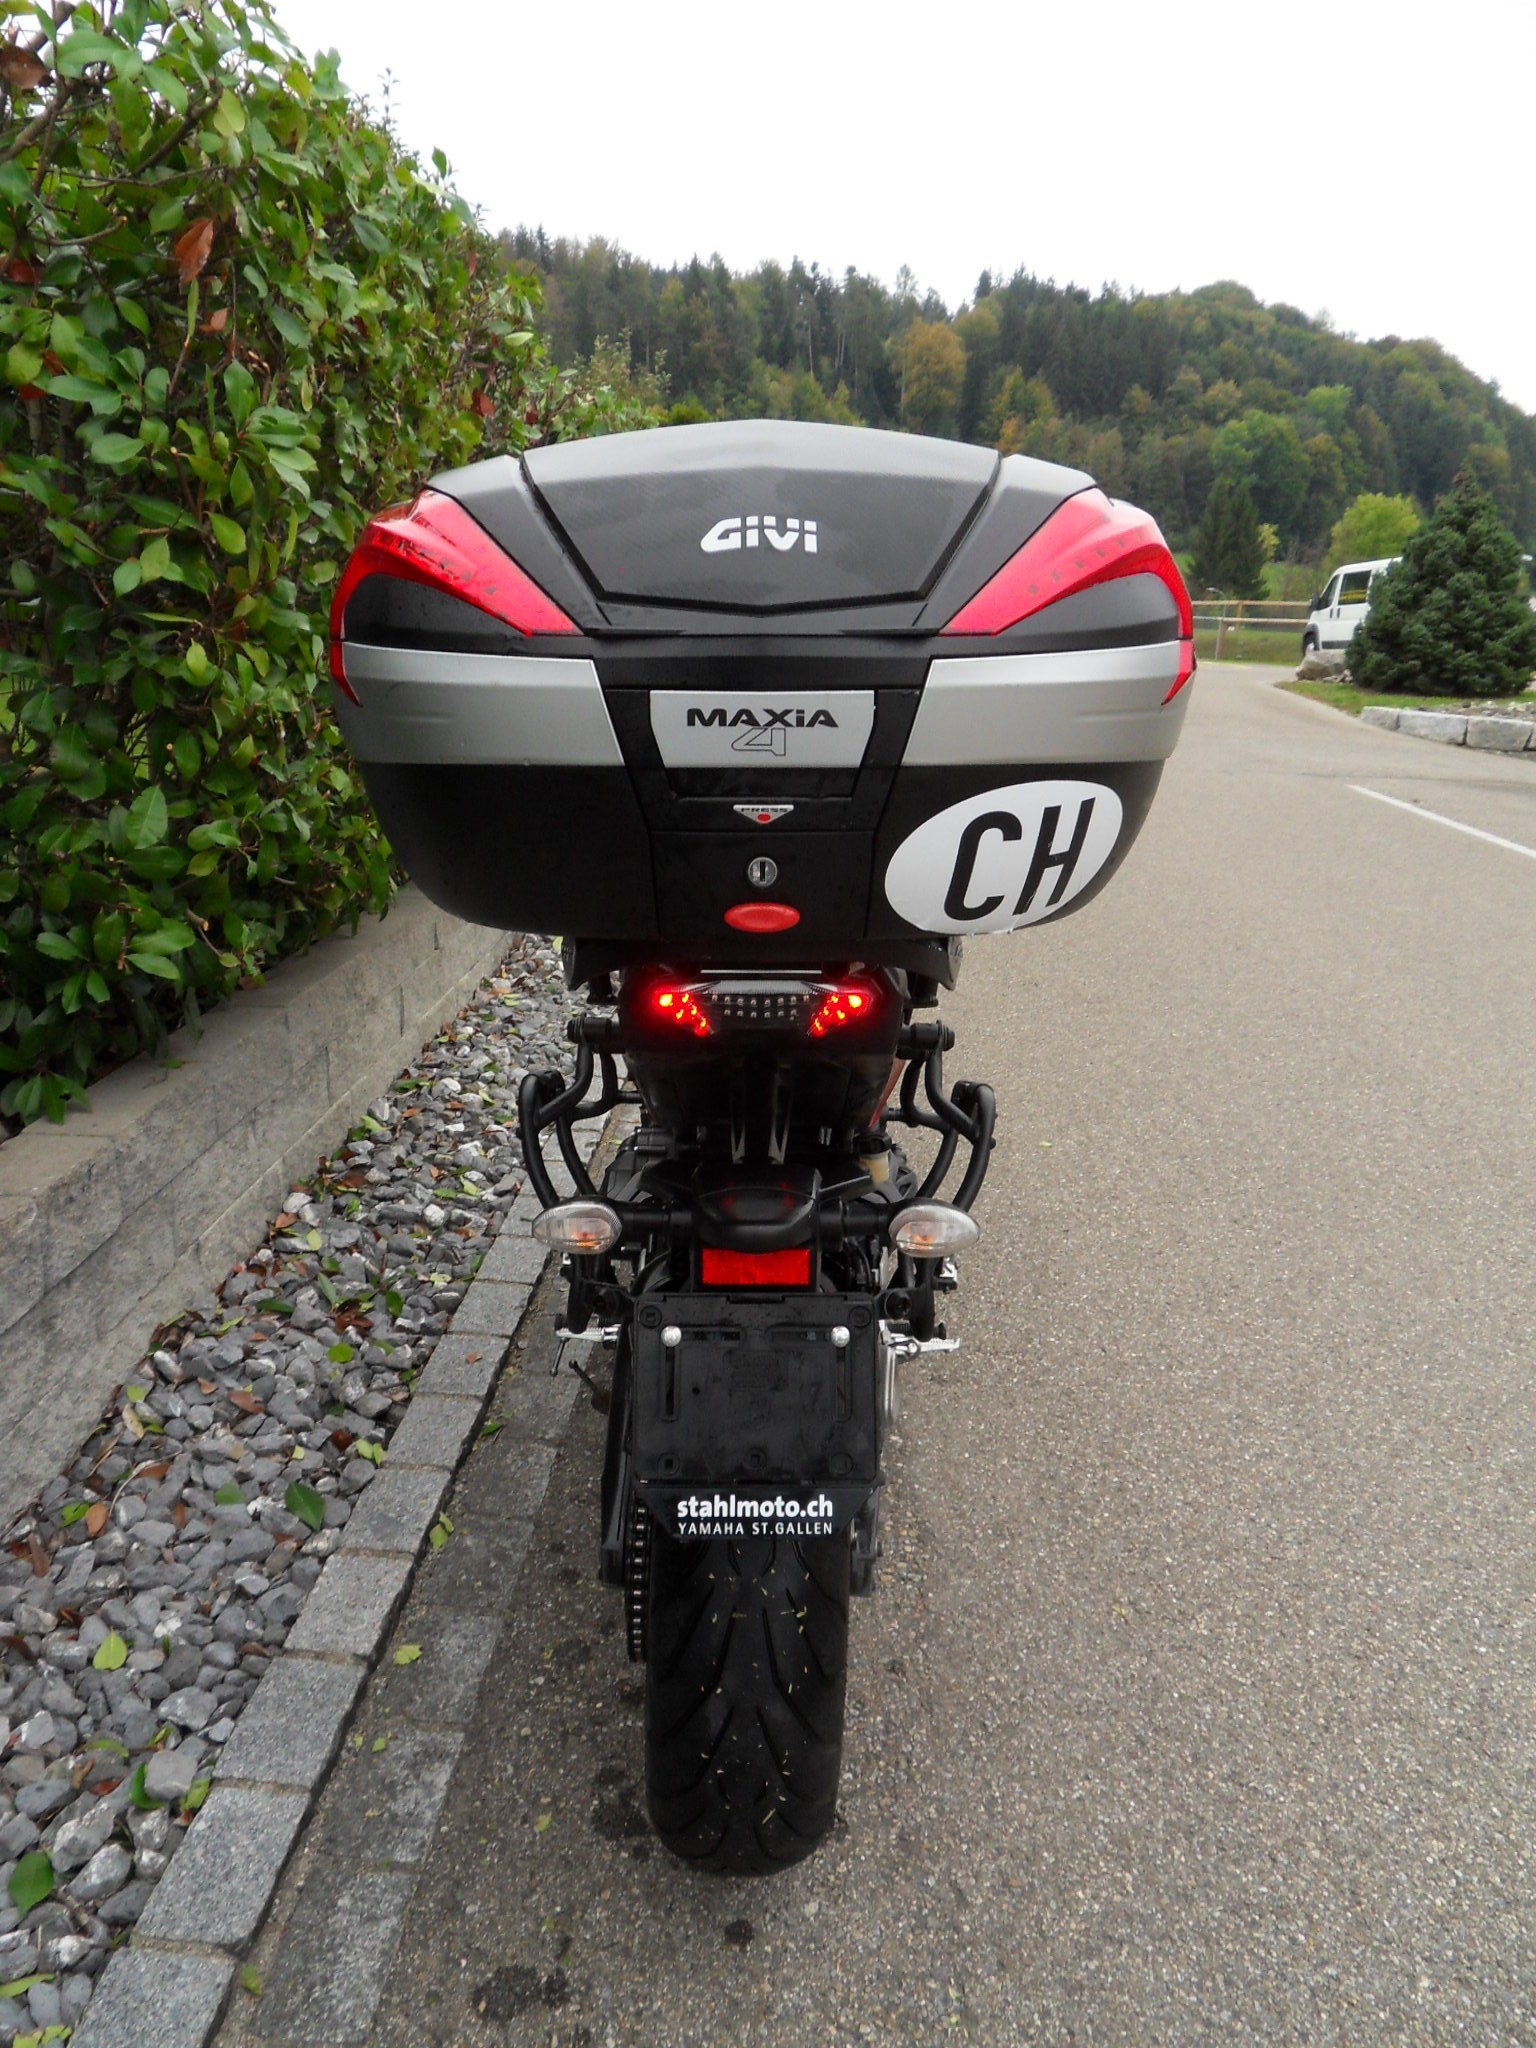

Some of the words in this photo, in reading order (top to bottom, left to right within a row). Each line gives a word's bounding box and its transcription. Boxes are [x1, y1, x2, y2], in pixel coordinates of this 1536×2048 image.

[943, 797, 1097, 921] CH
[677, 1494, 833, 1518] stahlmoto.ch
[678, 1522, 744, 1535] YAMAHA
[752, 1522, 833, 1535] ST.GALLEN
